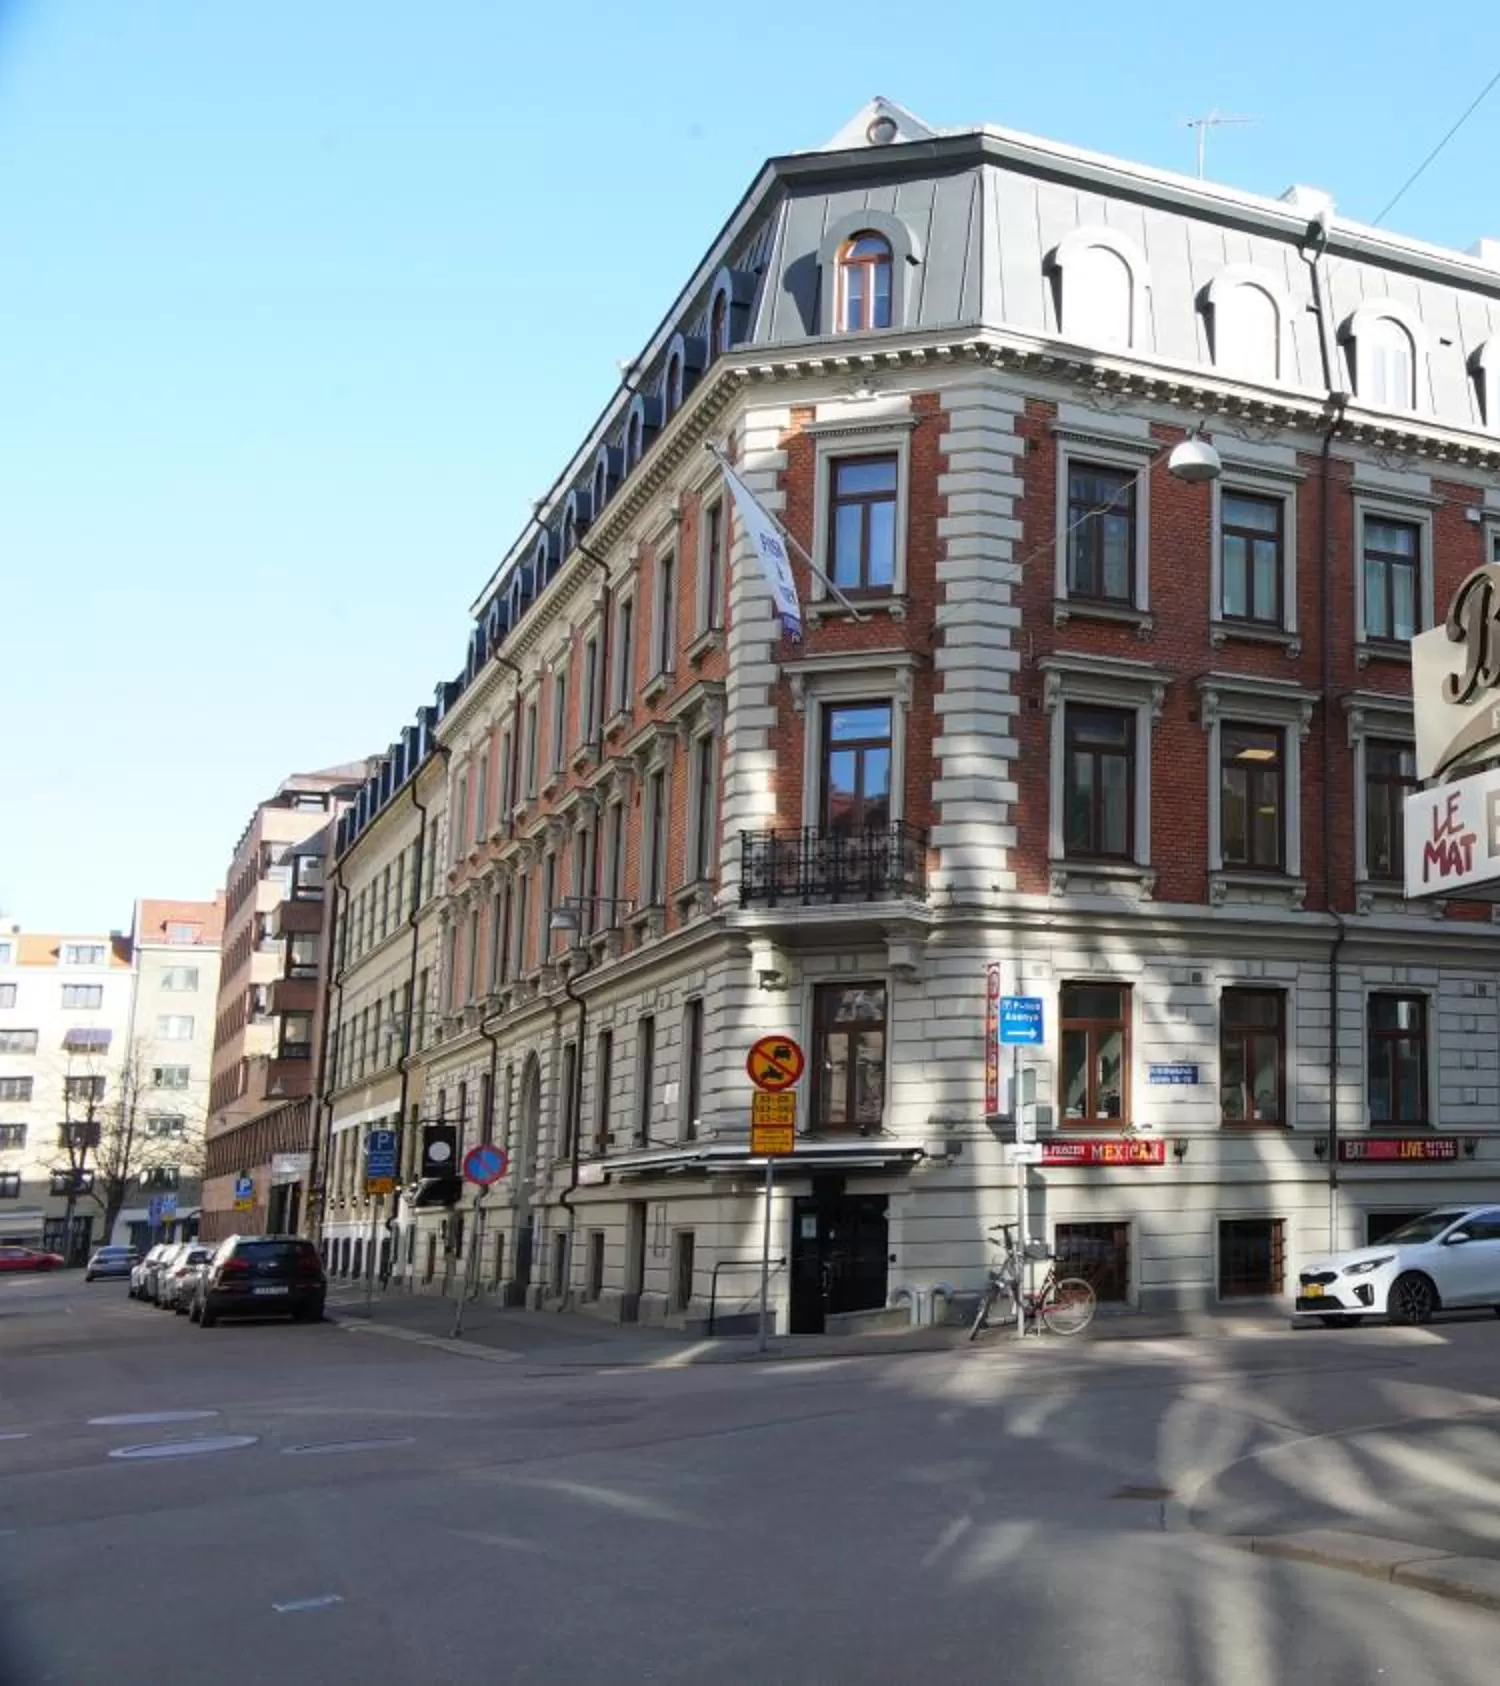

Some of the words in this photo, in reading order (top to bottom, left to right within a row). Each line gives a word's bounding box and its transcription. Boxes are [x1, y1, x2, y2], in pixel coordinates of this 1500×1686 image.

[1432, 790, 1465, 843] LE
[1423, 832, 1477, 884] MAT
[1090, 1143, 1161, 1162] MEXICAN
